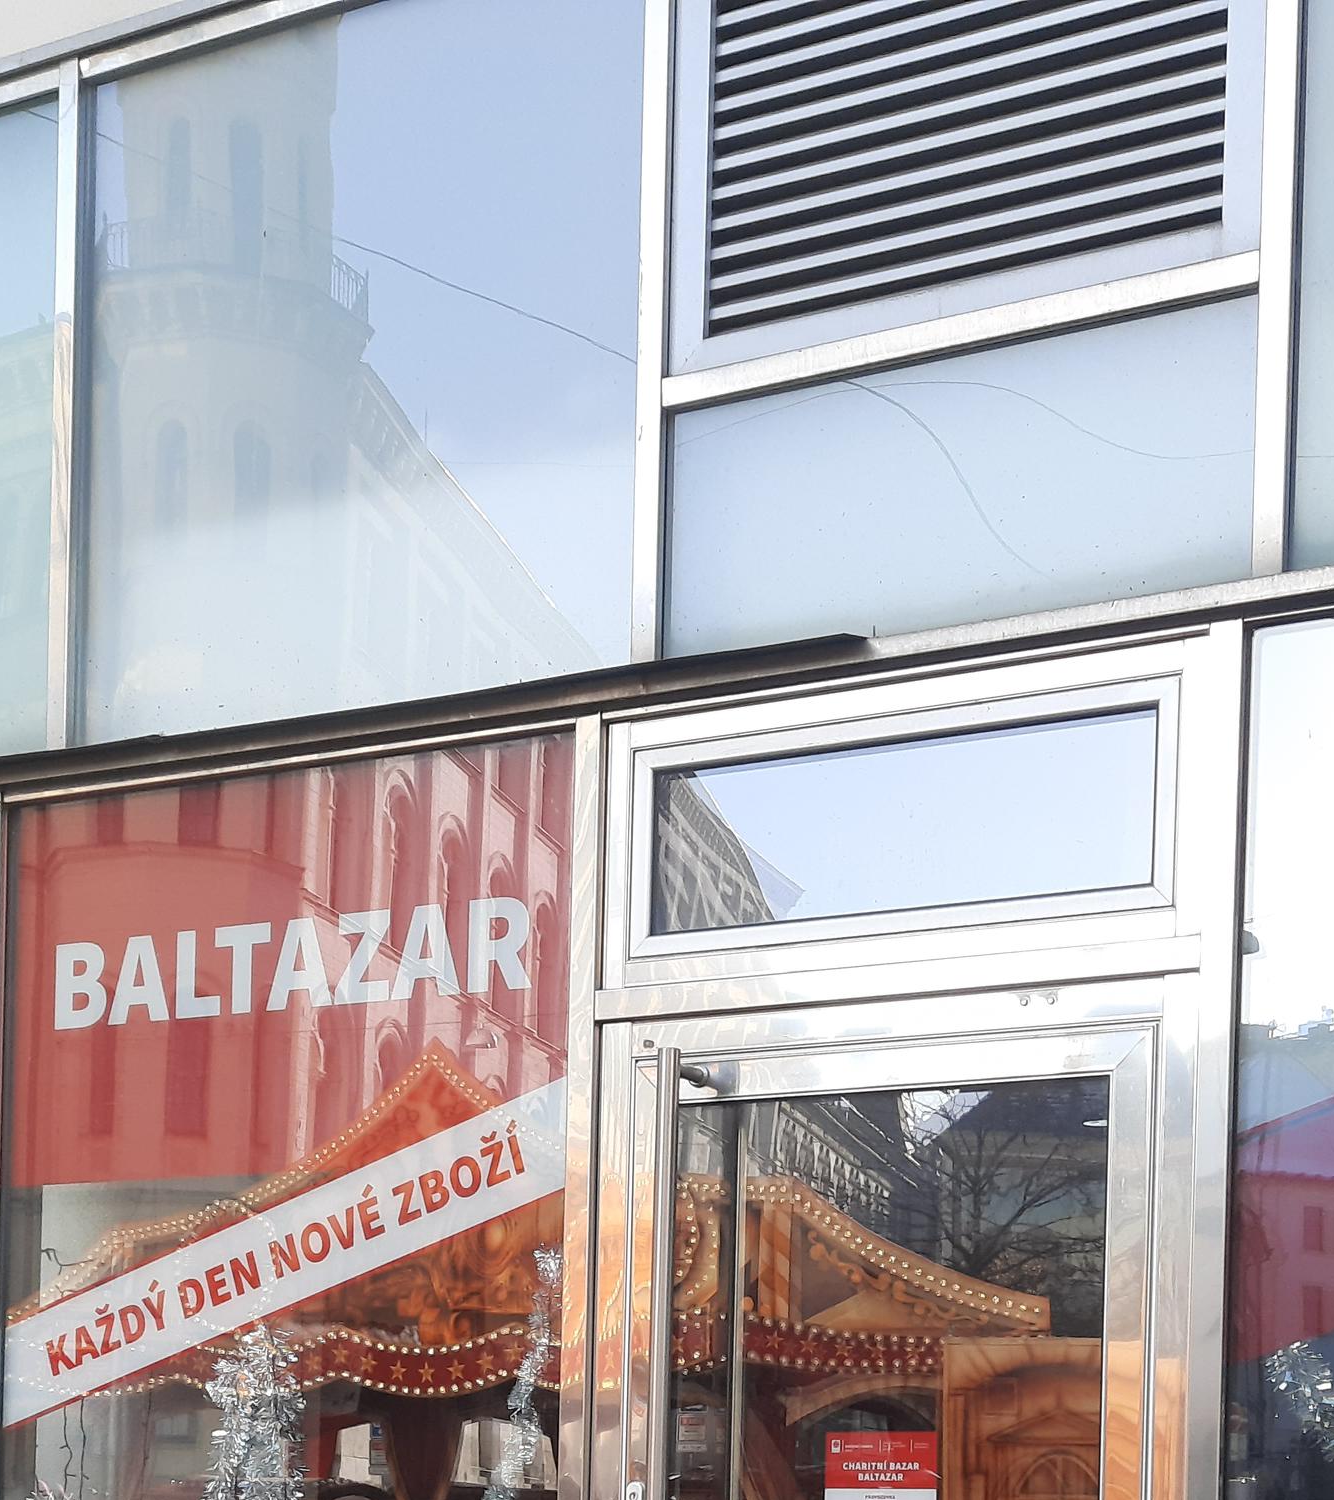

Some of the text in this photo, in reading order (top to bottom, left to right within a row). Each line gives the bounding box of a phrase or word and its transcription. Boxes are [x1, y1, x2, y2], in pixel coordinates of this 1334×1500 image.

[53, 896, 533, 1031] BALTAZAR
[44, 1119, 525, 1377] KAŽDÝ DEN NOVÉ ZBOŽÍ
[842, 1460, 920, 1471] CHARITNÍ BAZAR
[857, 1473, 904, 1481] BALTAZAR
